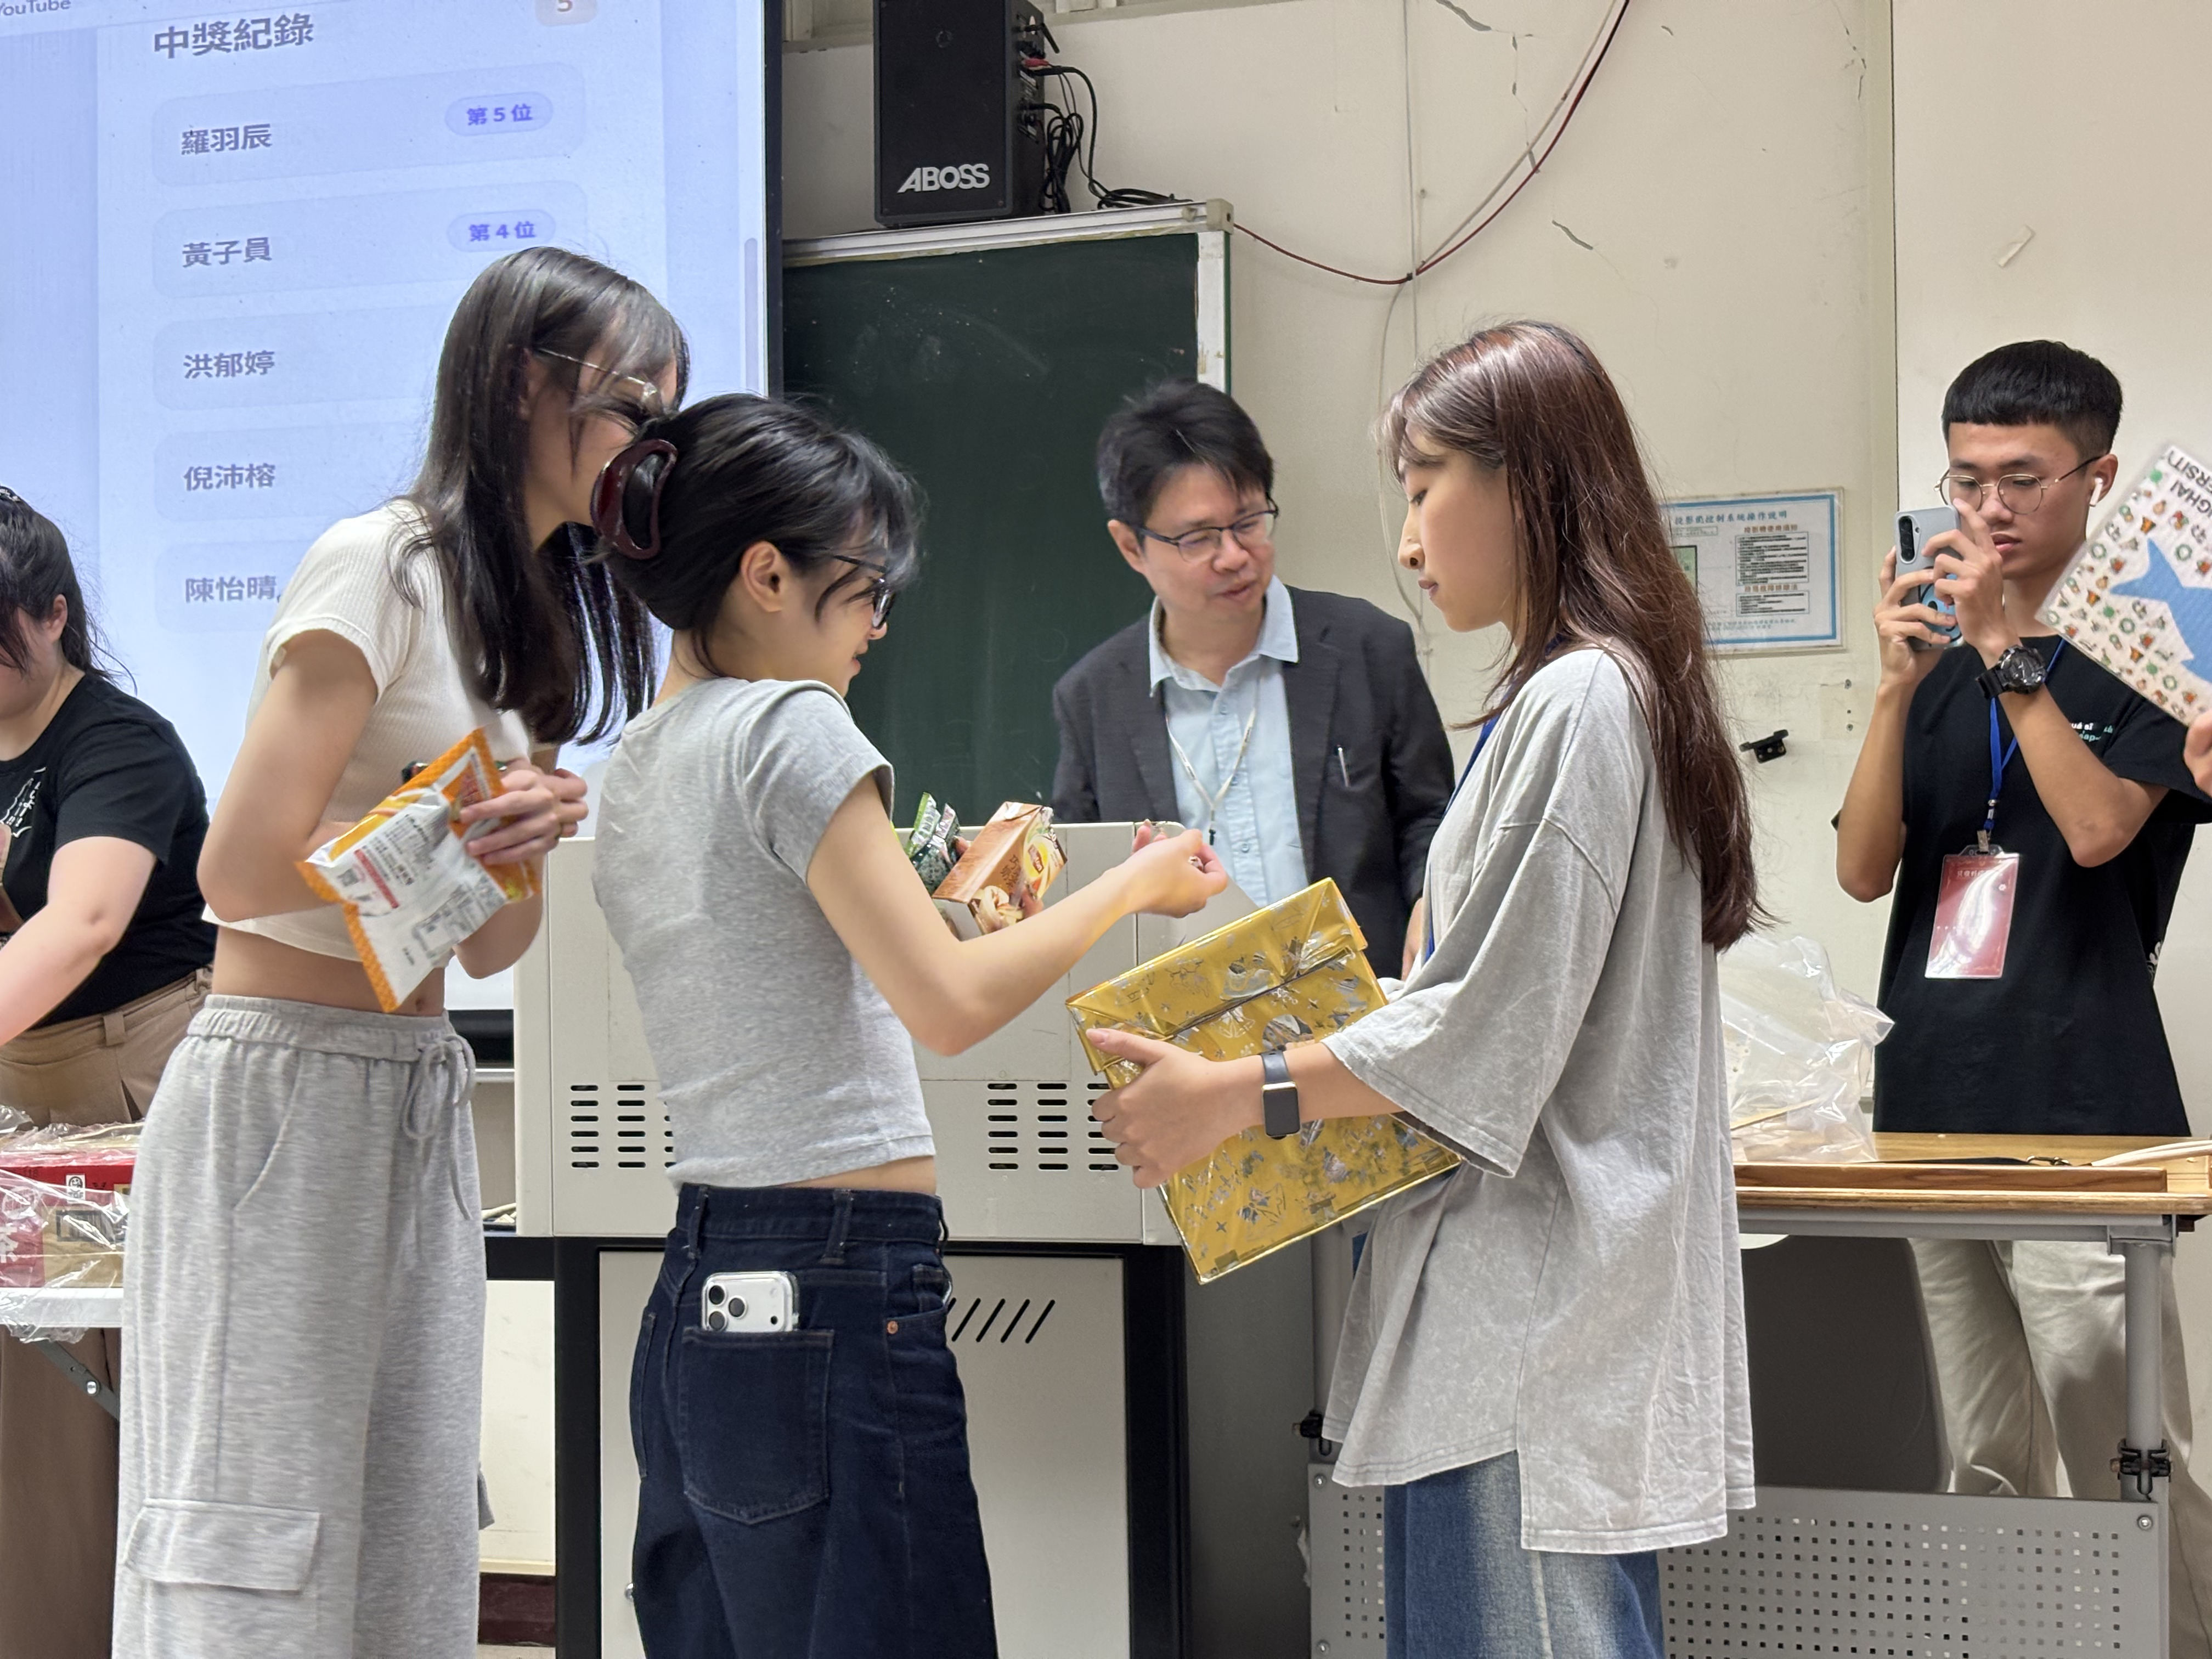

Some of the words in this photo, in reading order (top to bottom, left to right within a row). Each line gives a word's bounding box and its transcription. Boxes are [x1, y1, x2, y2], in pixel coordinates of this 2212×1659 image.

[154, 13, 314, 59] 中獎紀錄
[181, 123, 272, 155] 羅羽辰
[897, 163, 990, 193] ABOSS
[182, 237, 272, 268] 黃子員
[183, 350, 275, 379] 洪郁婷
[184, 463, 276, 491] 倪沛榕
[185, 576, 276, 603] 陳怡晴
